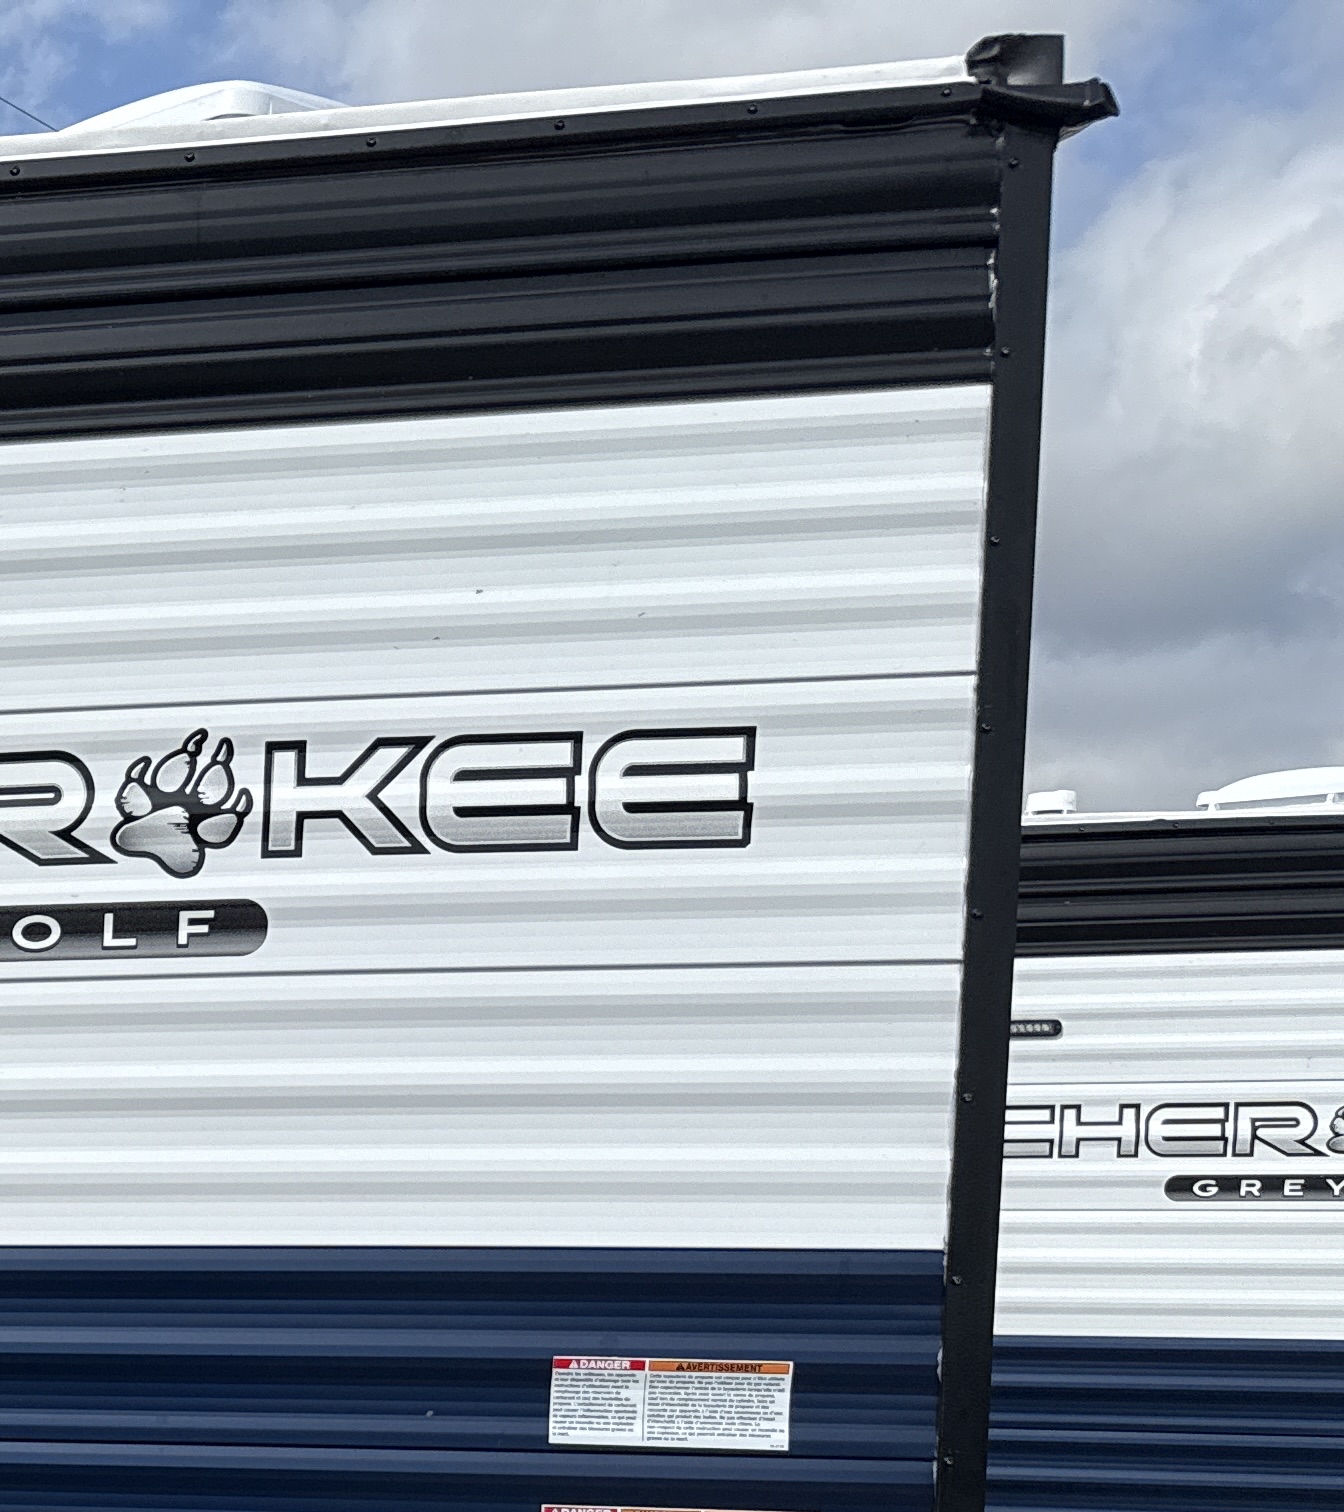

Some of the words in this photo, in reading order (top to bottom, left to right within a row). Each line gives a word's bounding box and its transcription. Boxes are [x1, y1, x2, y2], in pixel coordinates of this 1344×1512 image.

[1192, 1177, 1344, 1199] GREY
[579, 1359, 632, 1370] DANGER
[685, 1361, 764, 1374] AVERTISSEMENT
